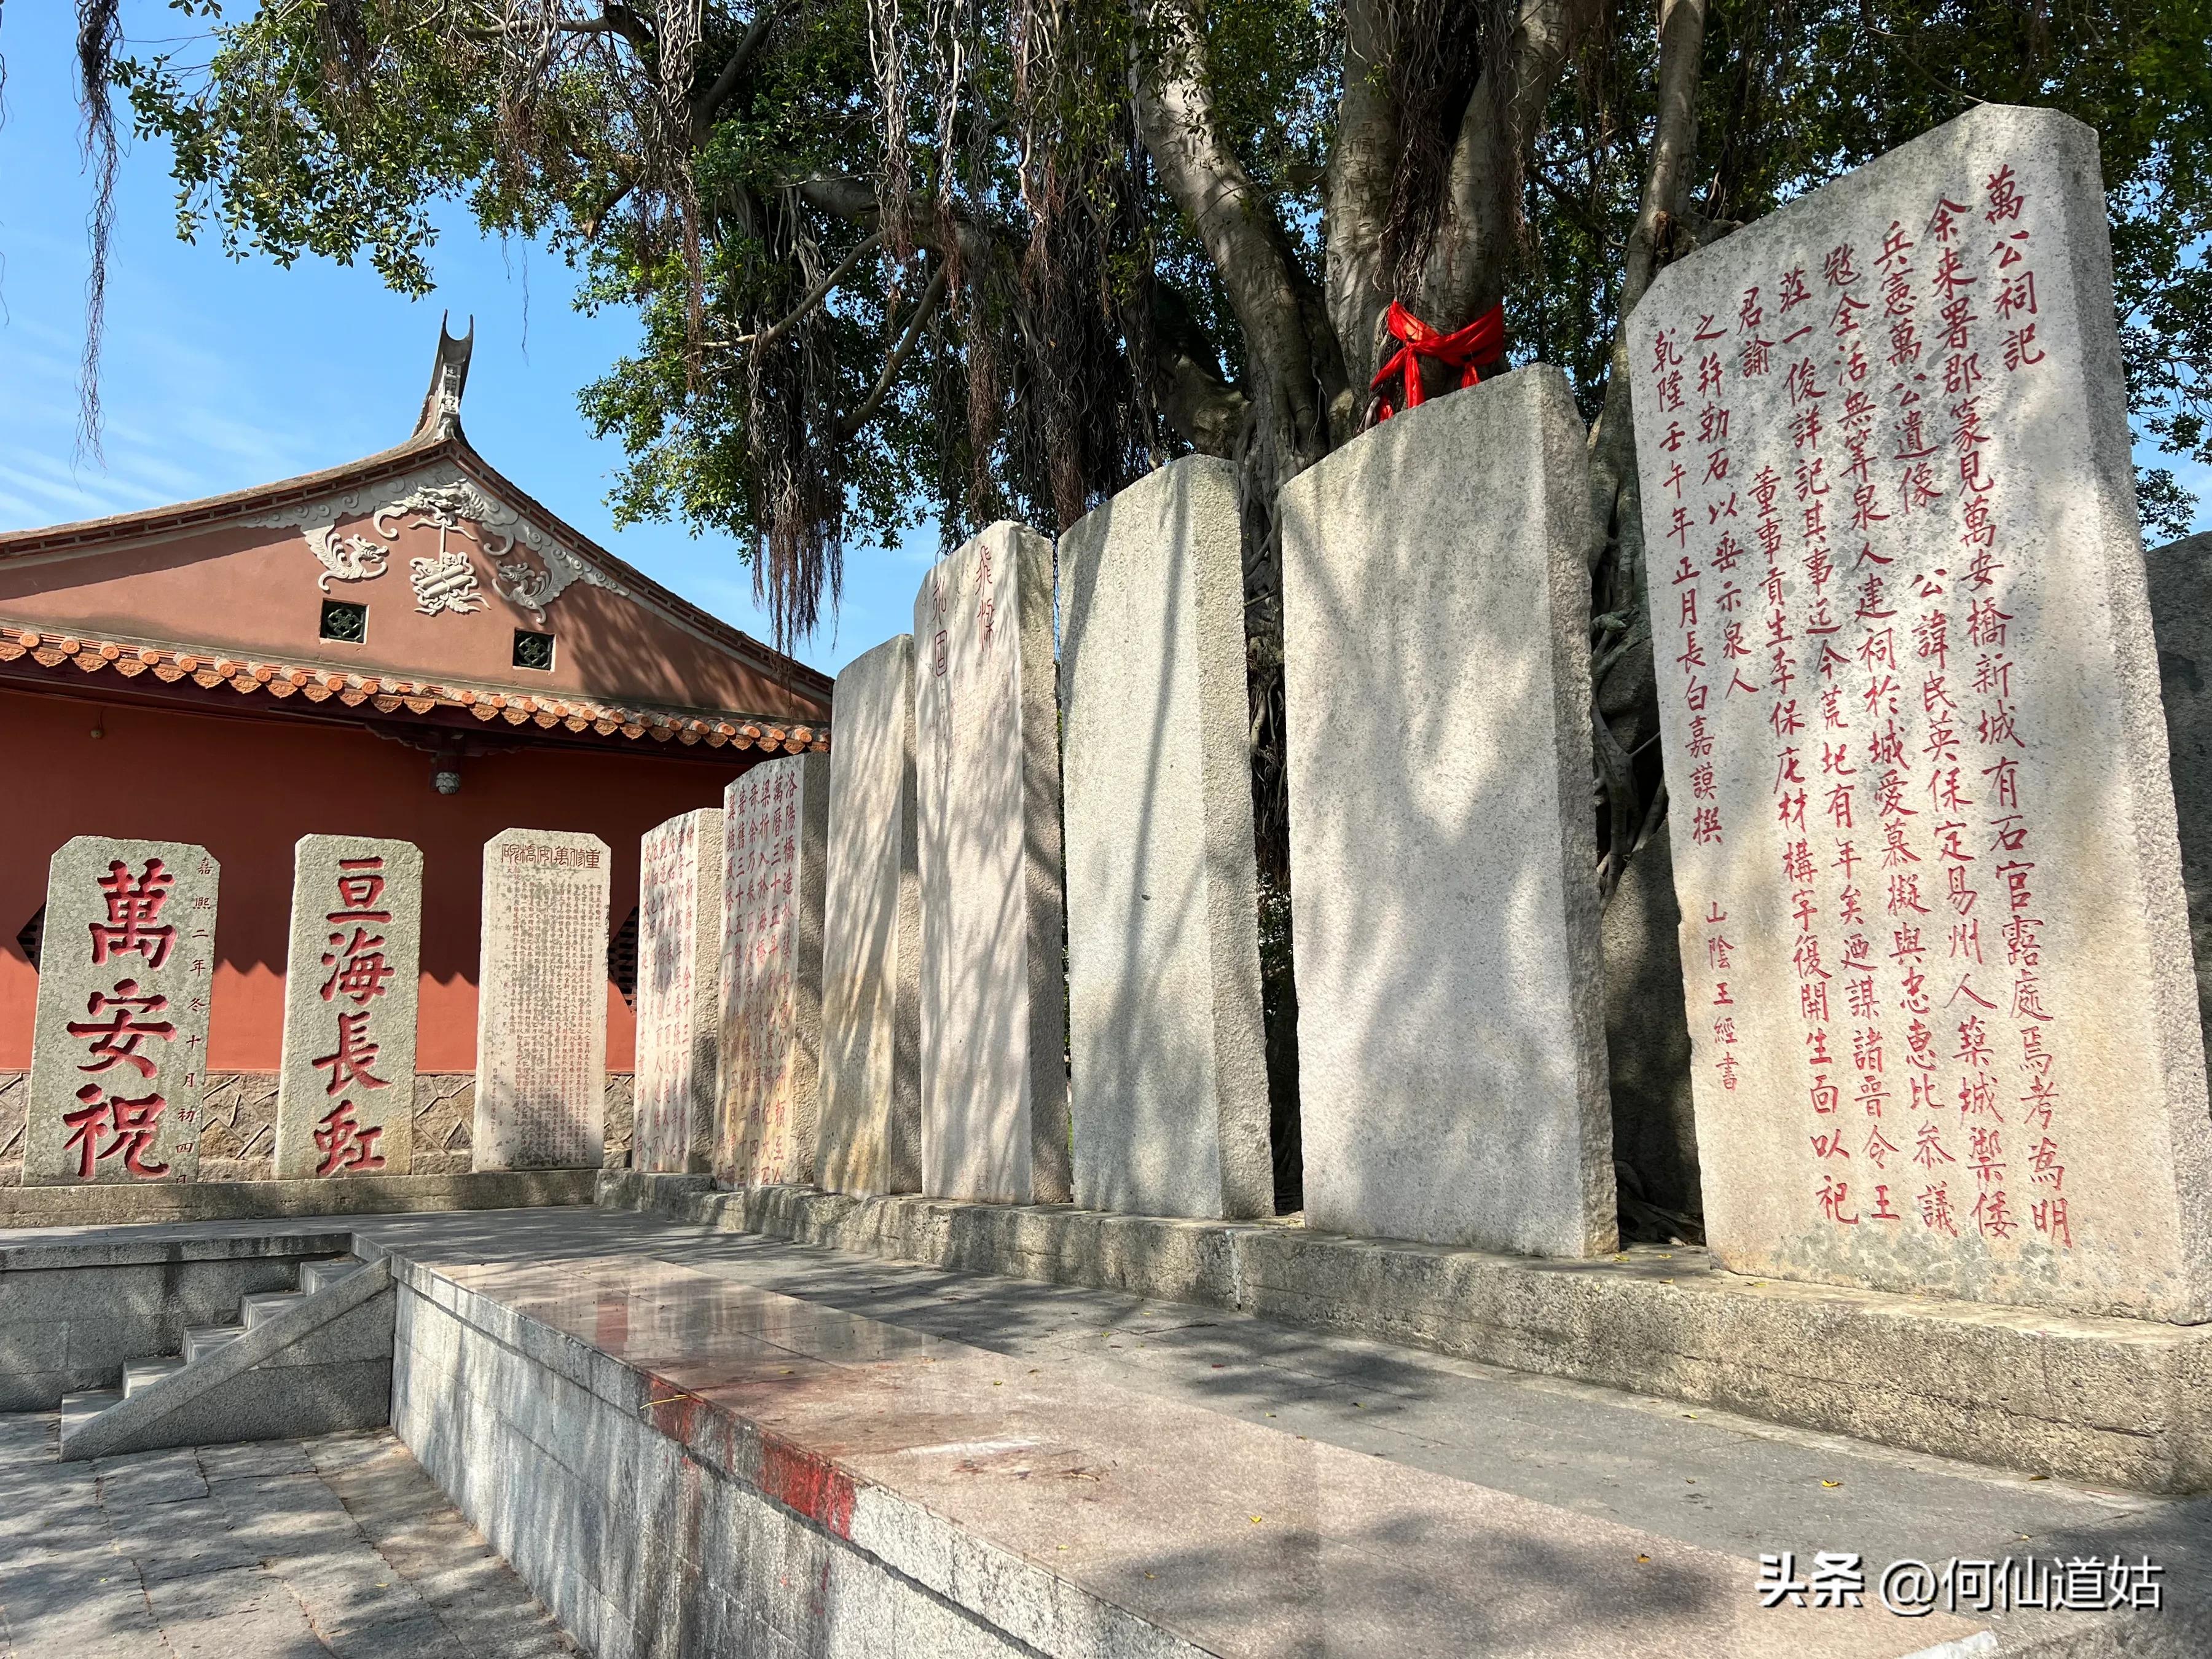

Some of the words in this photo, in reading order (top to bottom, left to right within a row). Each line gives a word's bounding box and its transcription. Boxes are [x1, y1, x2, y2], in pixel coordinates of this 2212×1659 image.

[1985, 163, 2045, 372] 萬公祠記
[63, 857, 178, 1179] 萬安祝
[311, 855, 396, 1177] 亘海長虹
